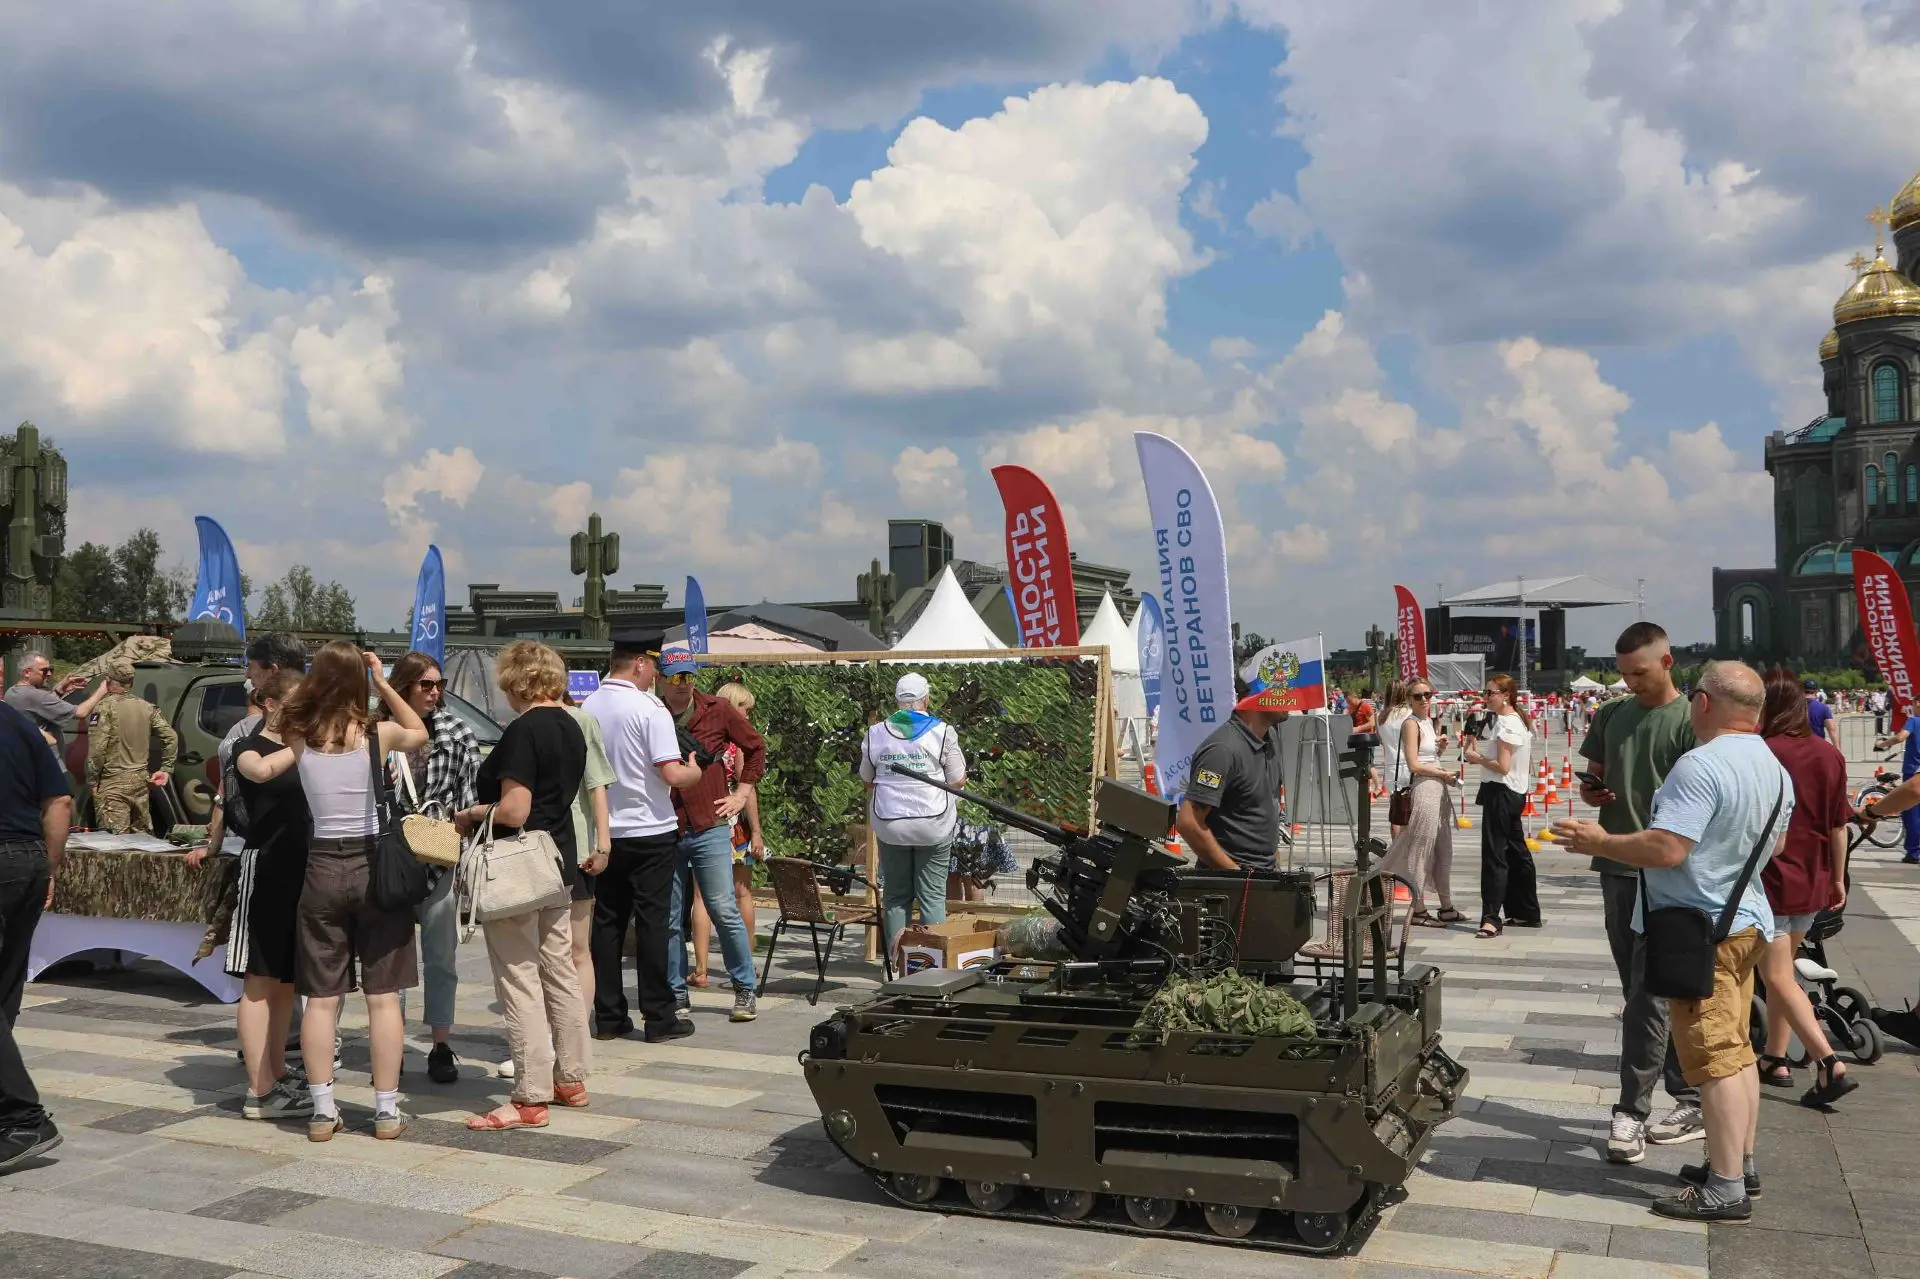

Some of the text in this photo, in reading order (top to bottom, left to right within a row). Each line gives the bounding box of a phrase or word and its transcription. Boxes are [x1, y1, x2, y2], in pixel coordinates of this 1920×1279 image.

[1156, 528, 1192, 724] АССОЦИАЦИЯ
[1177, 488, 1216, 723] ВЕТЕРАНОВ СВО
[1874, 574, 1913, 700] ДВИЖЕНИИ
[880, 752, 929, 761] СЕРЕБРЯНЫЙ
